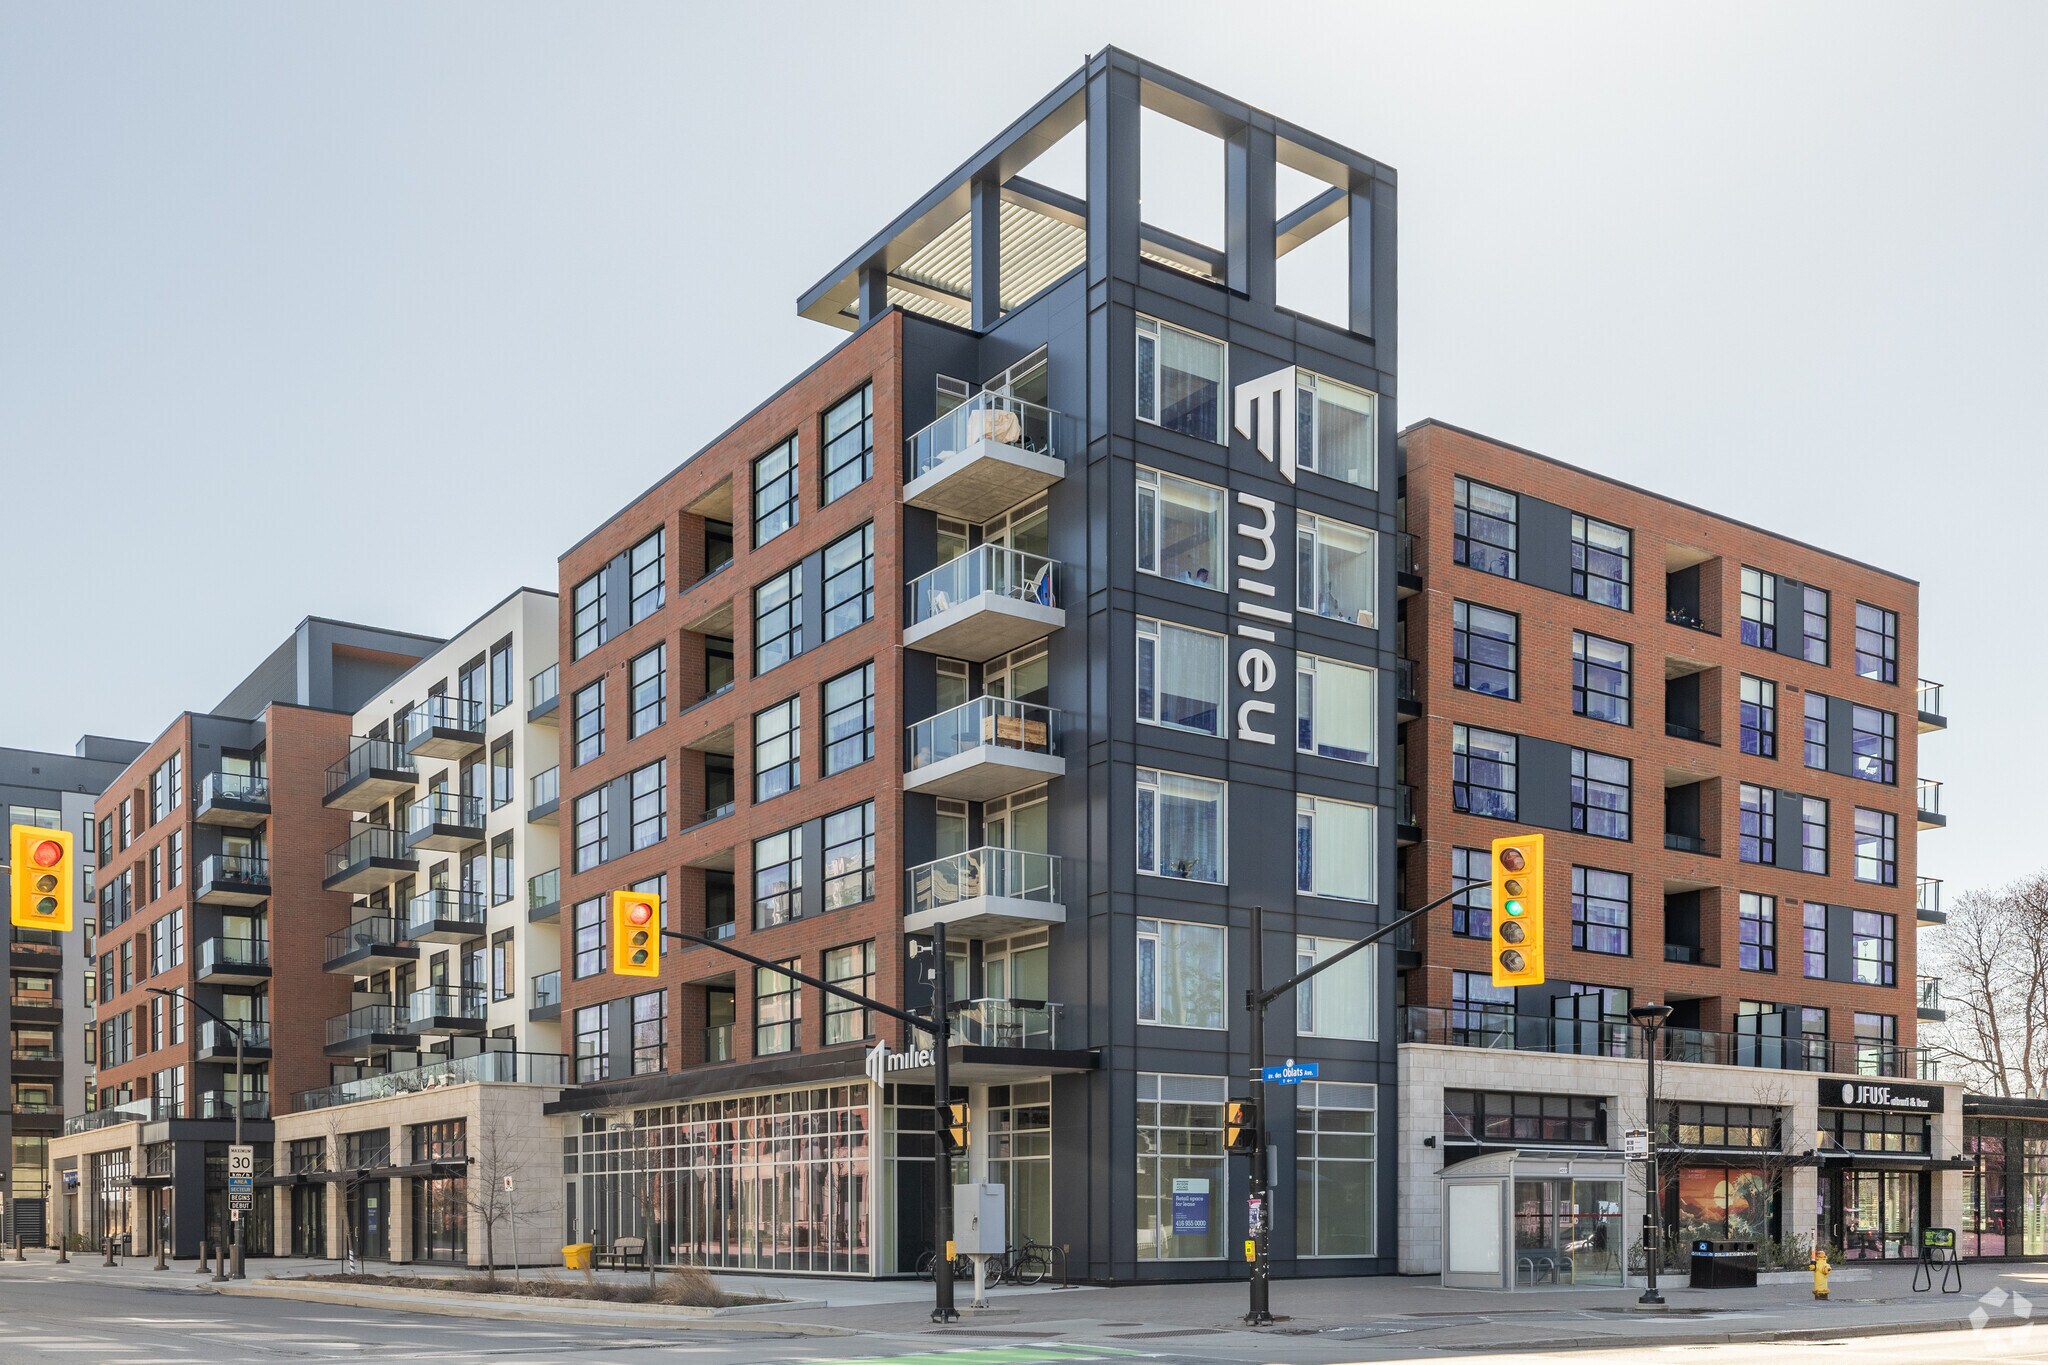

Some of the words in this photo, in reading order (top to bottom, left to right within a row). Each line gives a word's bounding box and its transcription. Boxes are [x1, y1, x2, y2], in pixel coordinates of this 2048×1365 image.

[1238, 492, 1292, 744] milieu
[1282, 1068, 1303, 1078] Oblats
[1856, 1086, 1890, 1105] JFUSE
[1910, 1098, 1916, 1107] &
[1917, 1098, 1929, 1107] bar
[232, 1157, 250, 1168] 30
